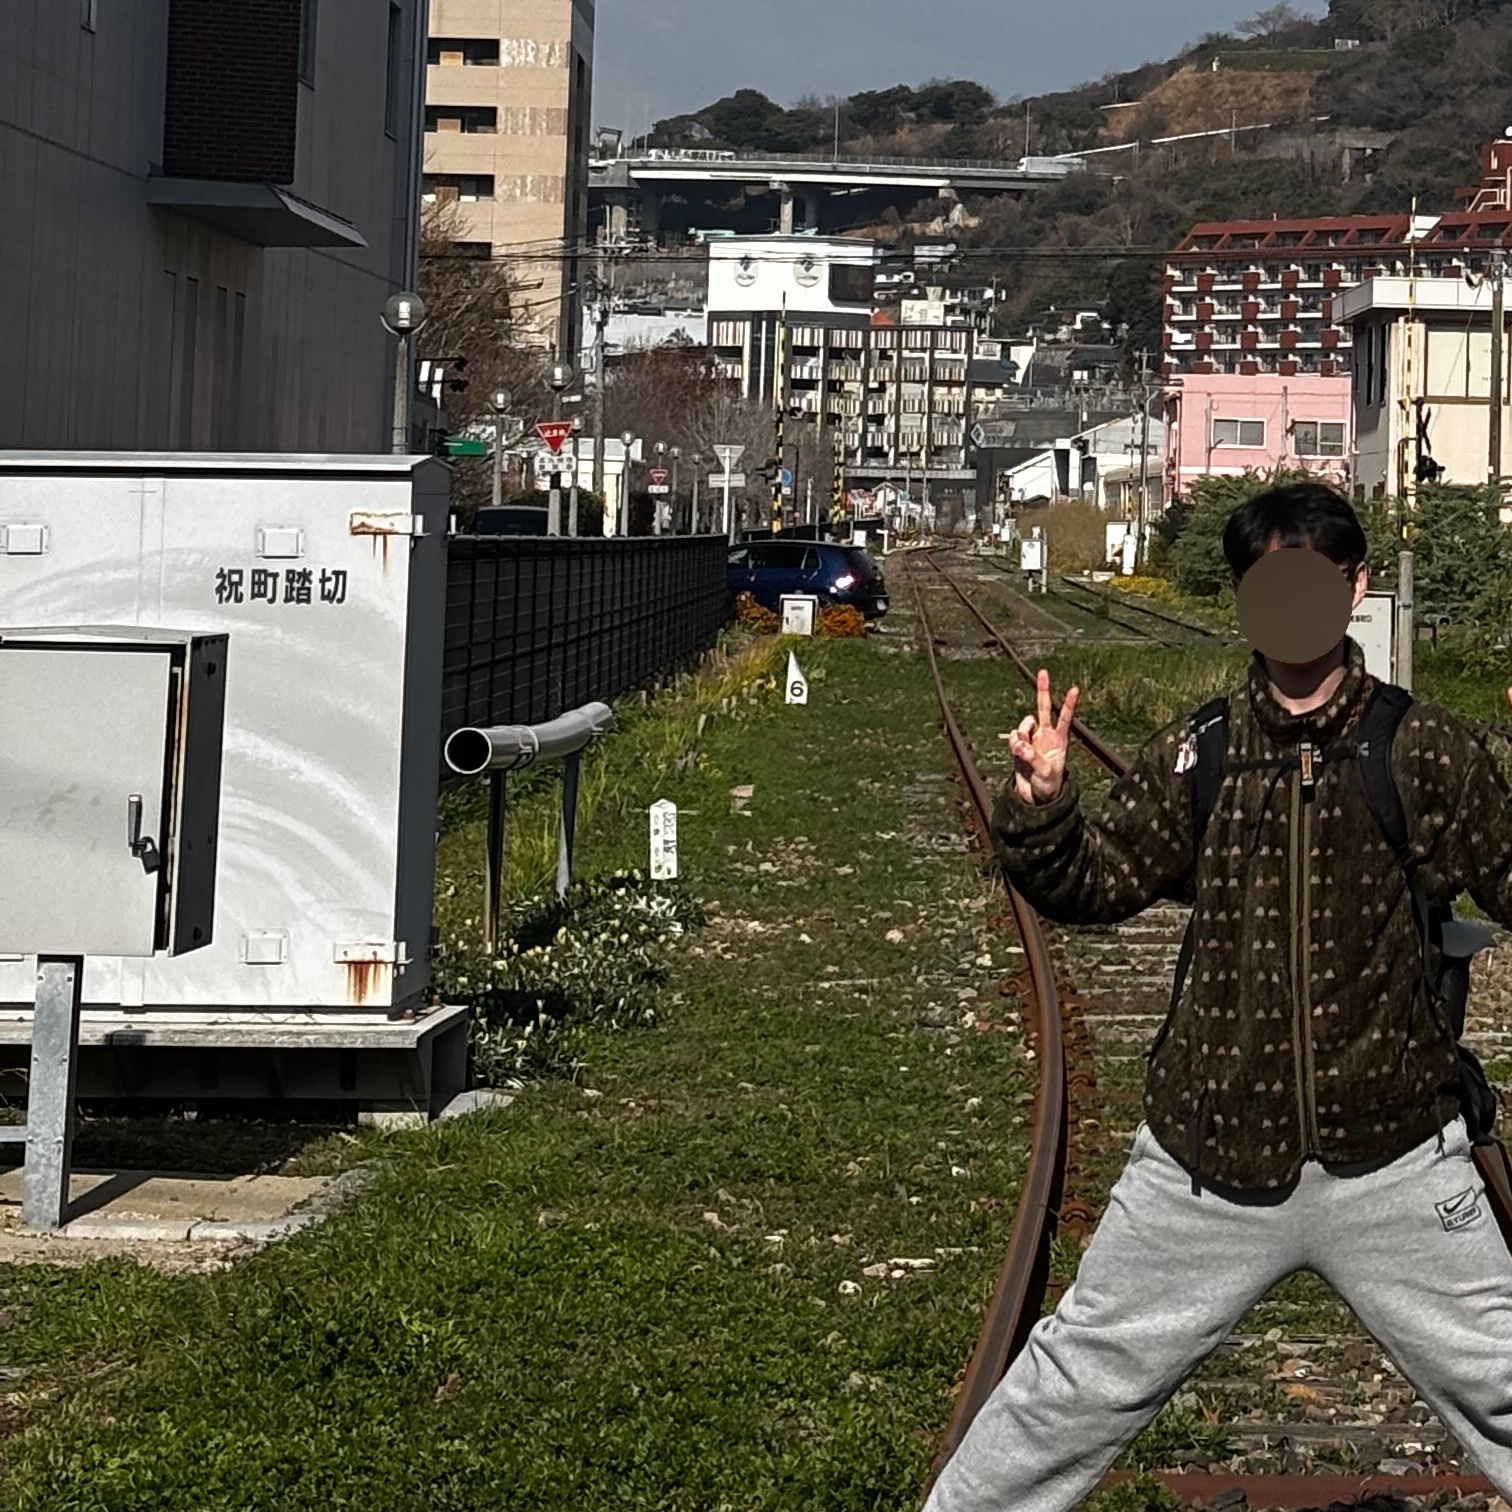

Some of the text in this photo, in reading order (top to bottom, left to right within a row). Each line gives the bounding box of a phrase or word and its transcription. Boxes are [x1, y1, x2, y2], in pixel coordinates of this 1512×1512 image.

[214, 566, 348, 605] 祝町踏切
[790, 680, 805, 698] 6
